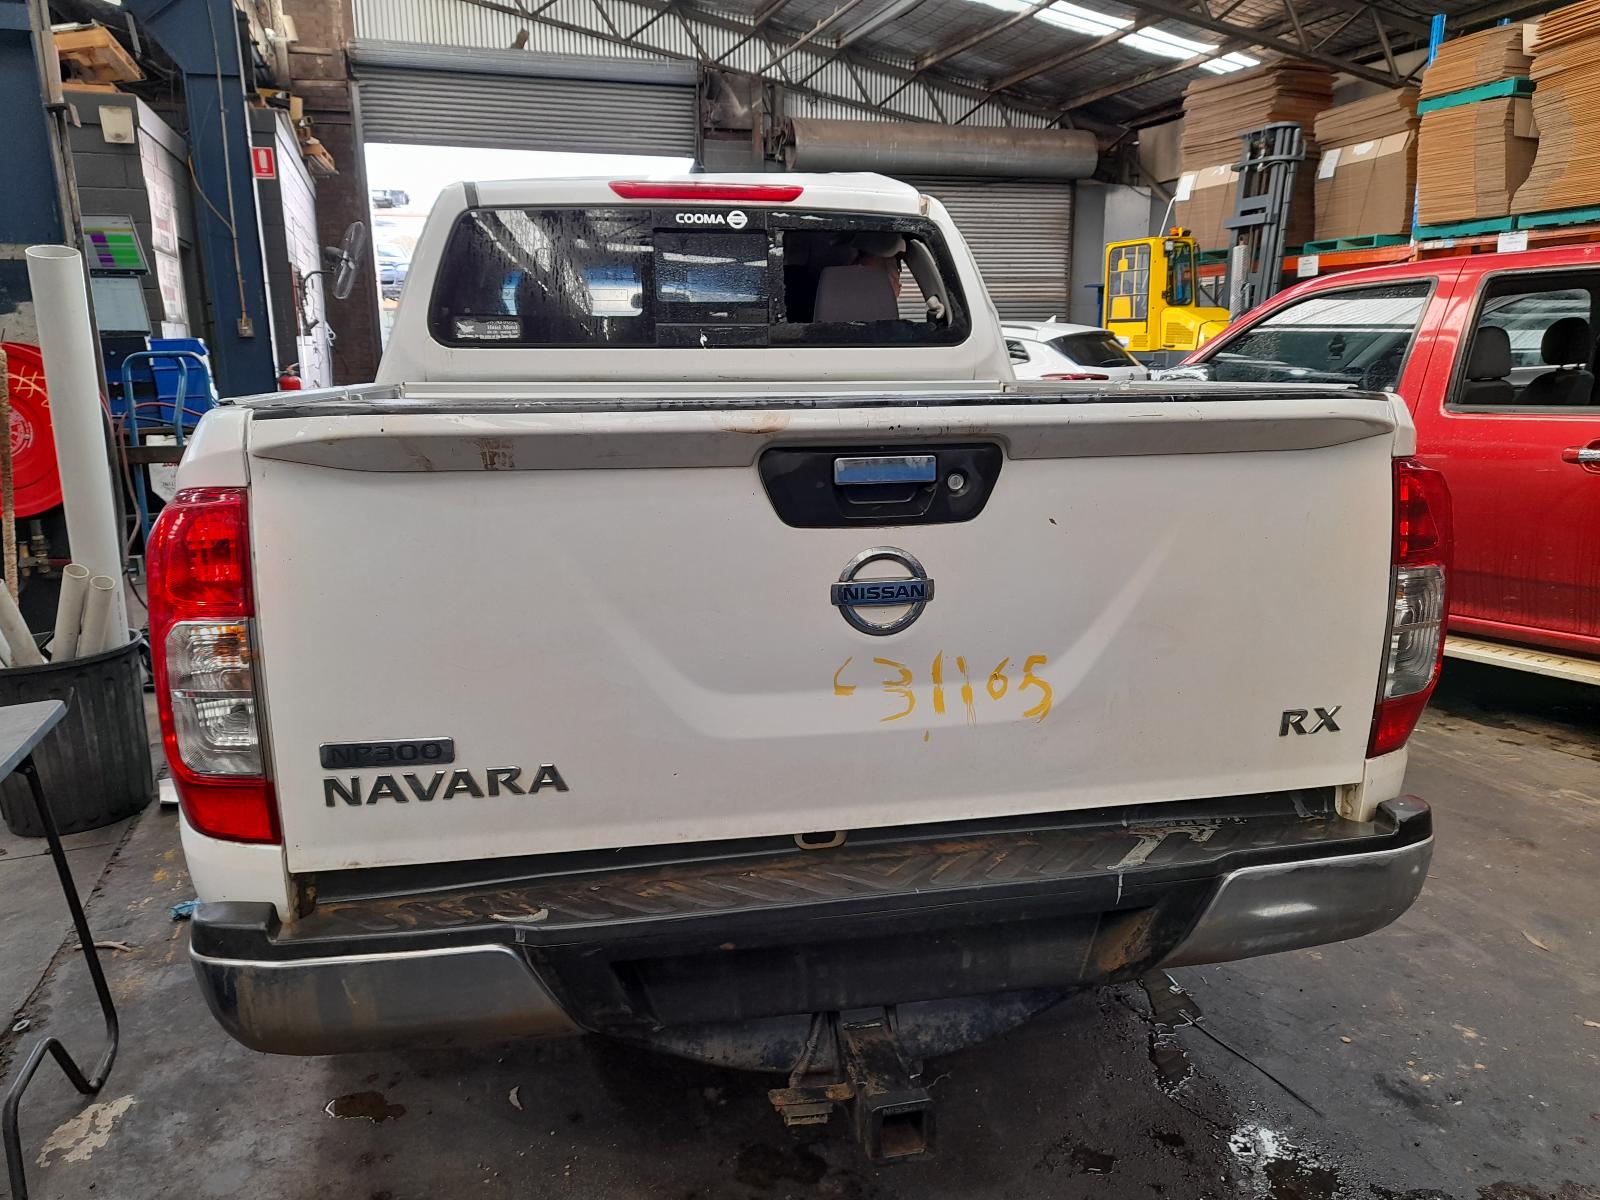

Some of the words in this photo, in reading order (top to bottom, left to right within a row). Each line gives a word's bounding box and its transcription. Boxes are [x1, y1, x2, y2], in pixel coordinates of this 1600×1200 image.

[675, 213, 726, 224] COOMA
[843, 583, 926, 601] NISSAN
[1279, 705, 1342, 737] RX
[330, 743, 443, 763] NP300
[323, 763, 570, 807] NAVARA
